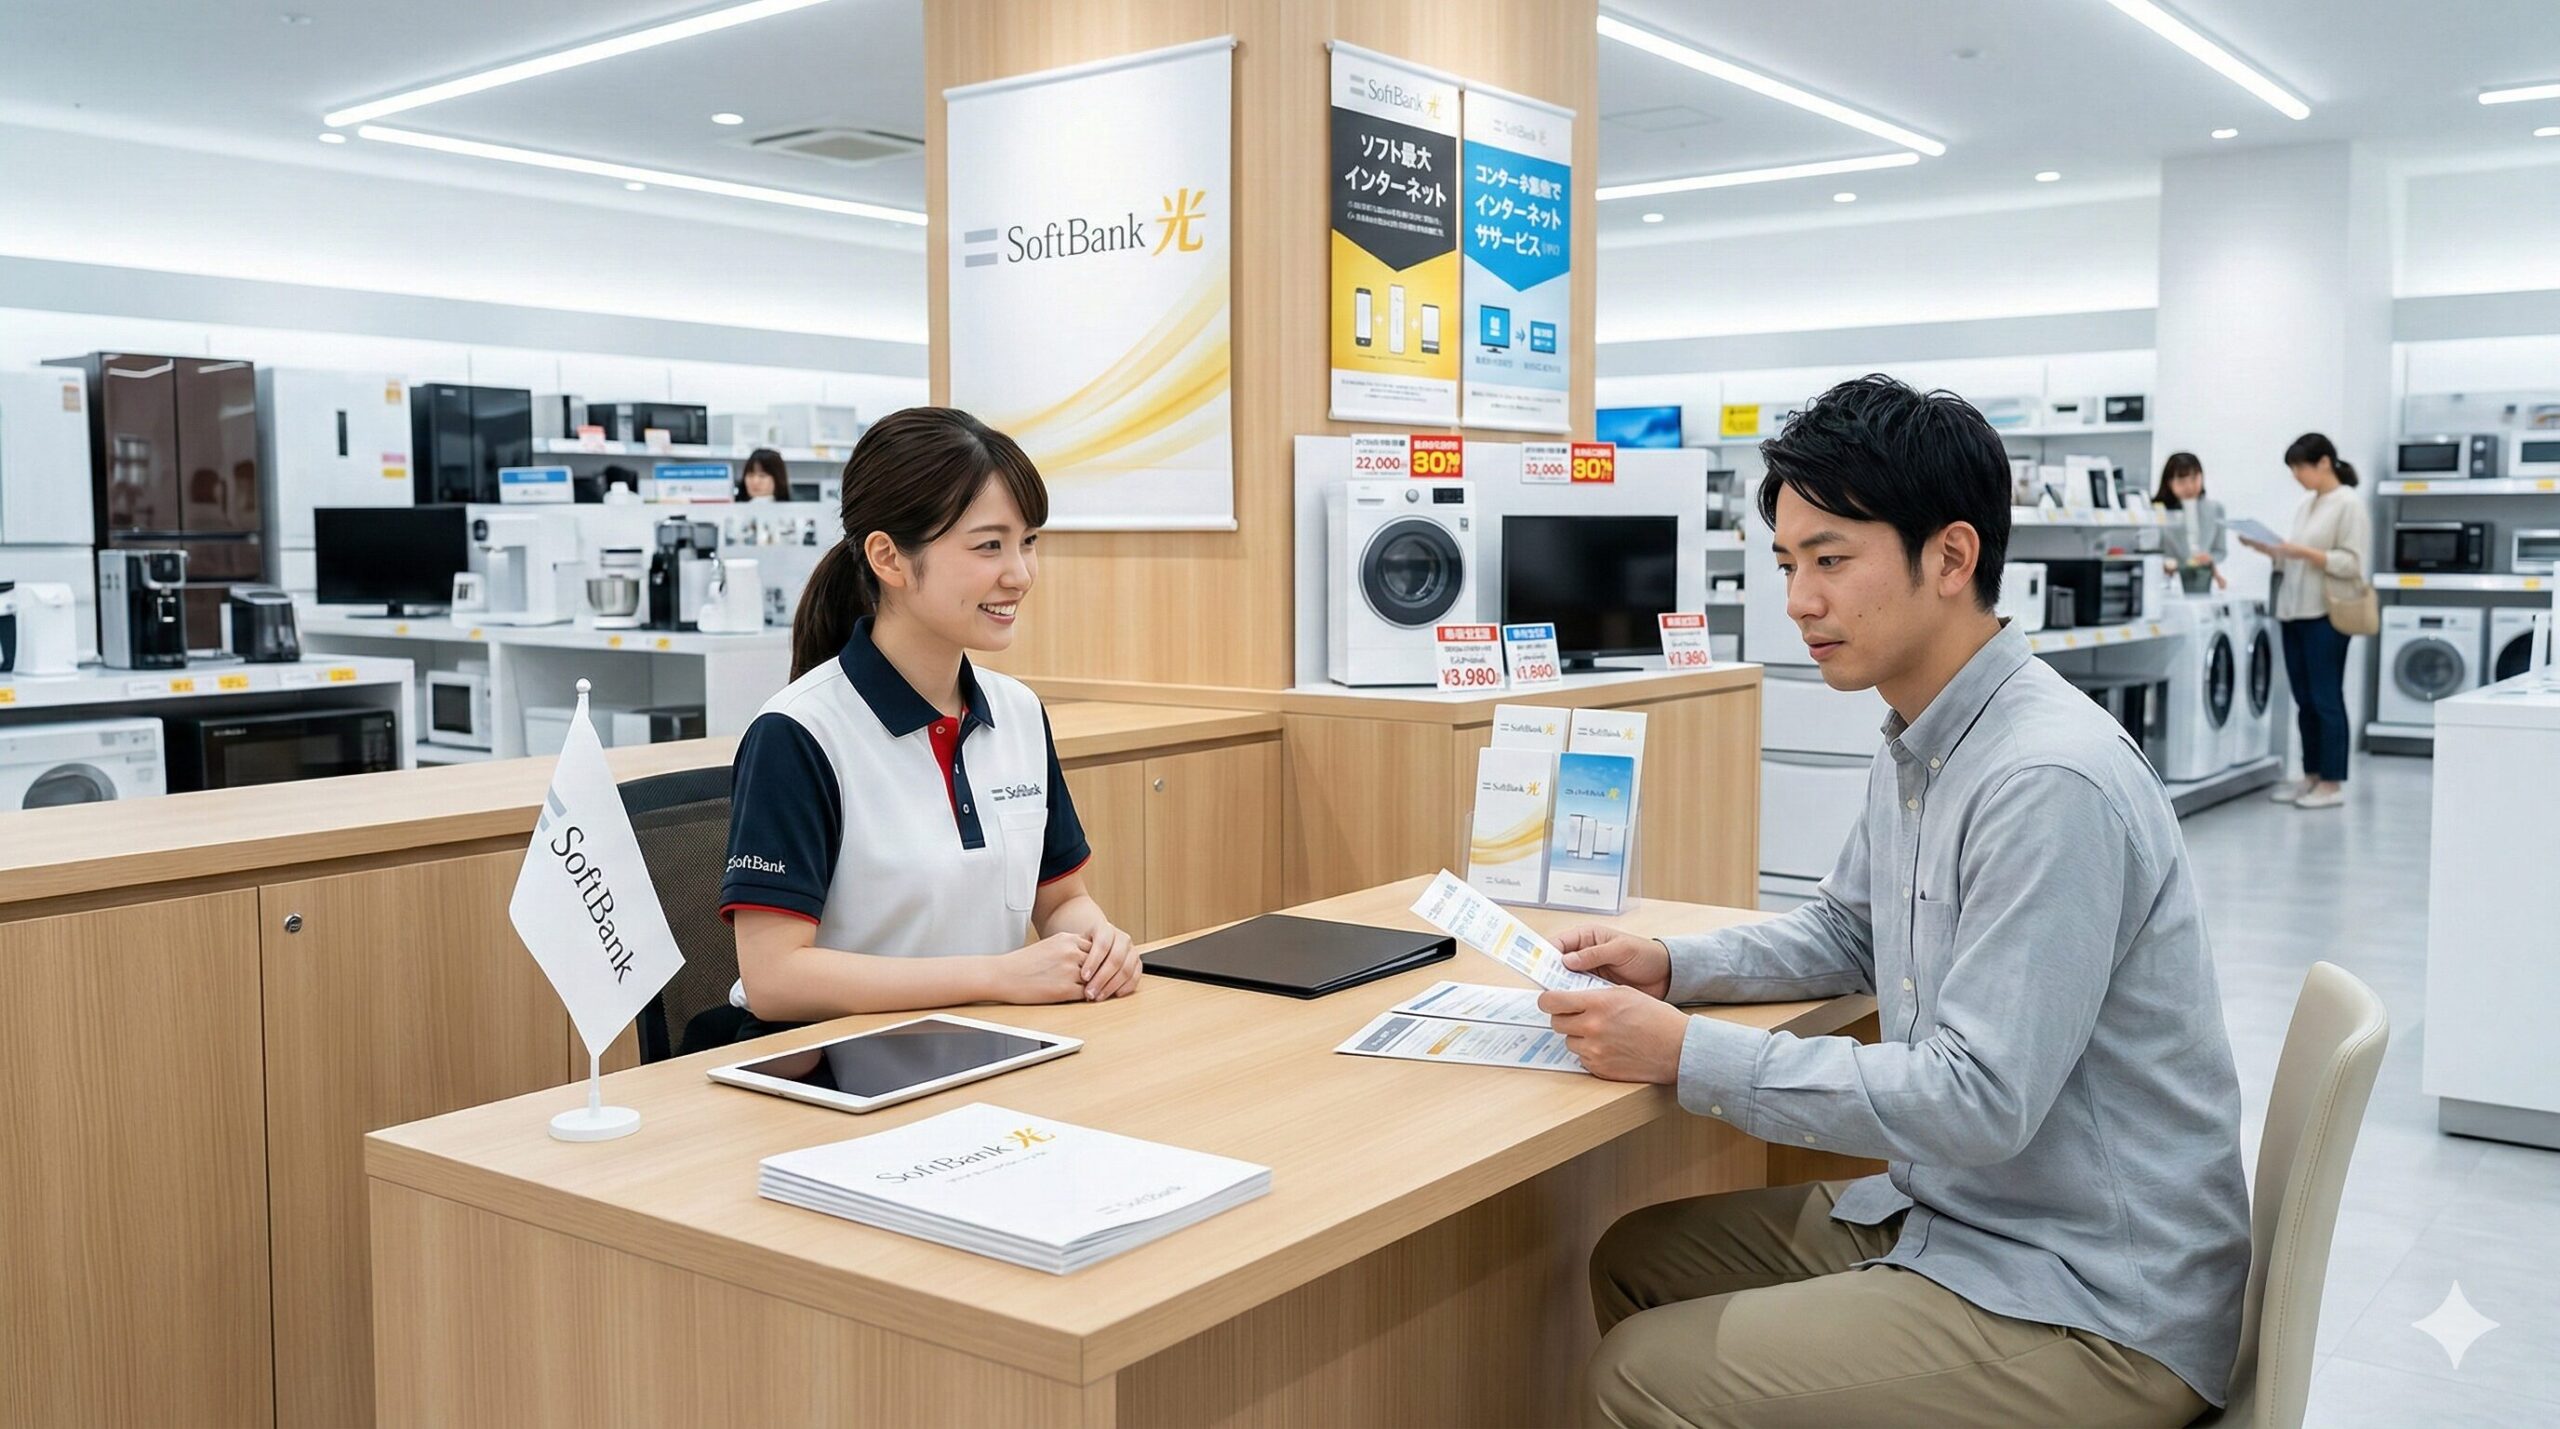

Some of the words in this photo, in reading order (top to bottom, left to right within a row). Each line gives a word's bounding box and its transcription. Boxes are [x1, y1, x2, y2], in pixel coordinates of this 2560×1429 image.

[1368, 79, 1424, 112] SoftBank
[1344, 165, 1447, 208] インターネット
[1007, 212, 1146, 263] SoftBank
[1151, 187, 1206, 257] 光
[1474, 193, 1562, 231] インターネット
[1474, 223, 1542, 257] ササービス
[1355, 456, 1400, 471] 22,000
[1441, 667, 1496, 687] ¥3,980
[550, 826, 634, 985] SoftBank
[876, 1143, 1014, 1184] SoftBank
